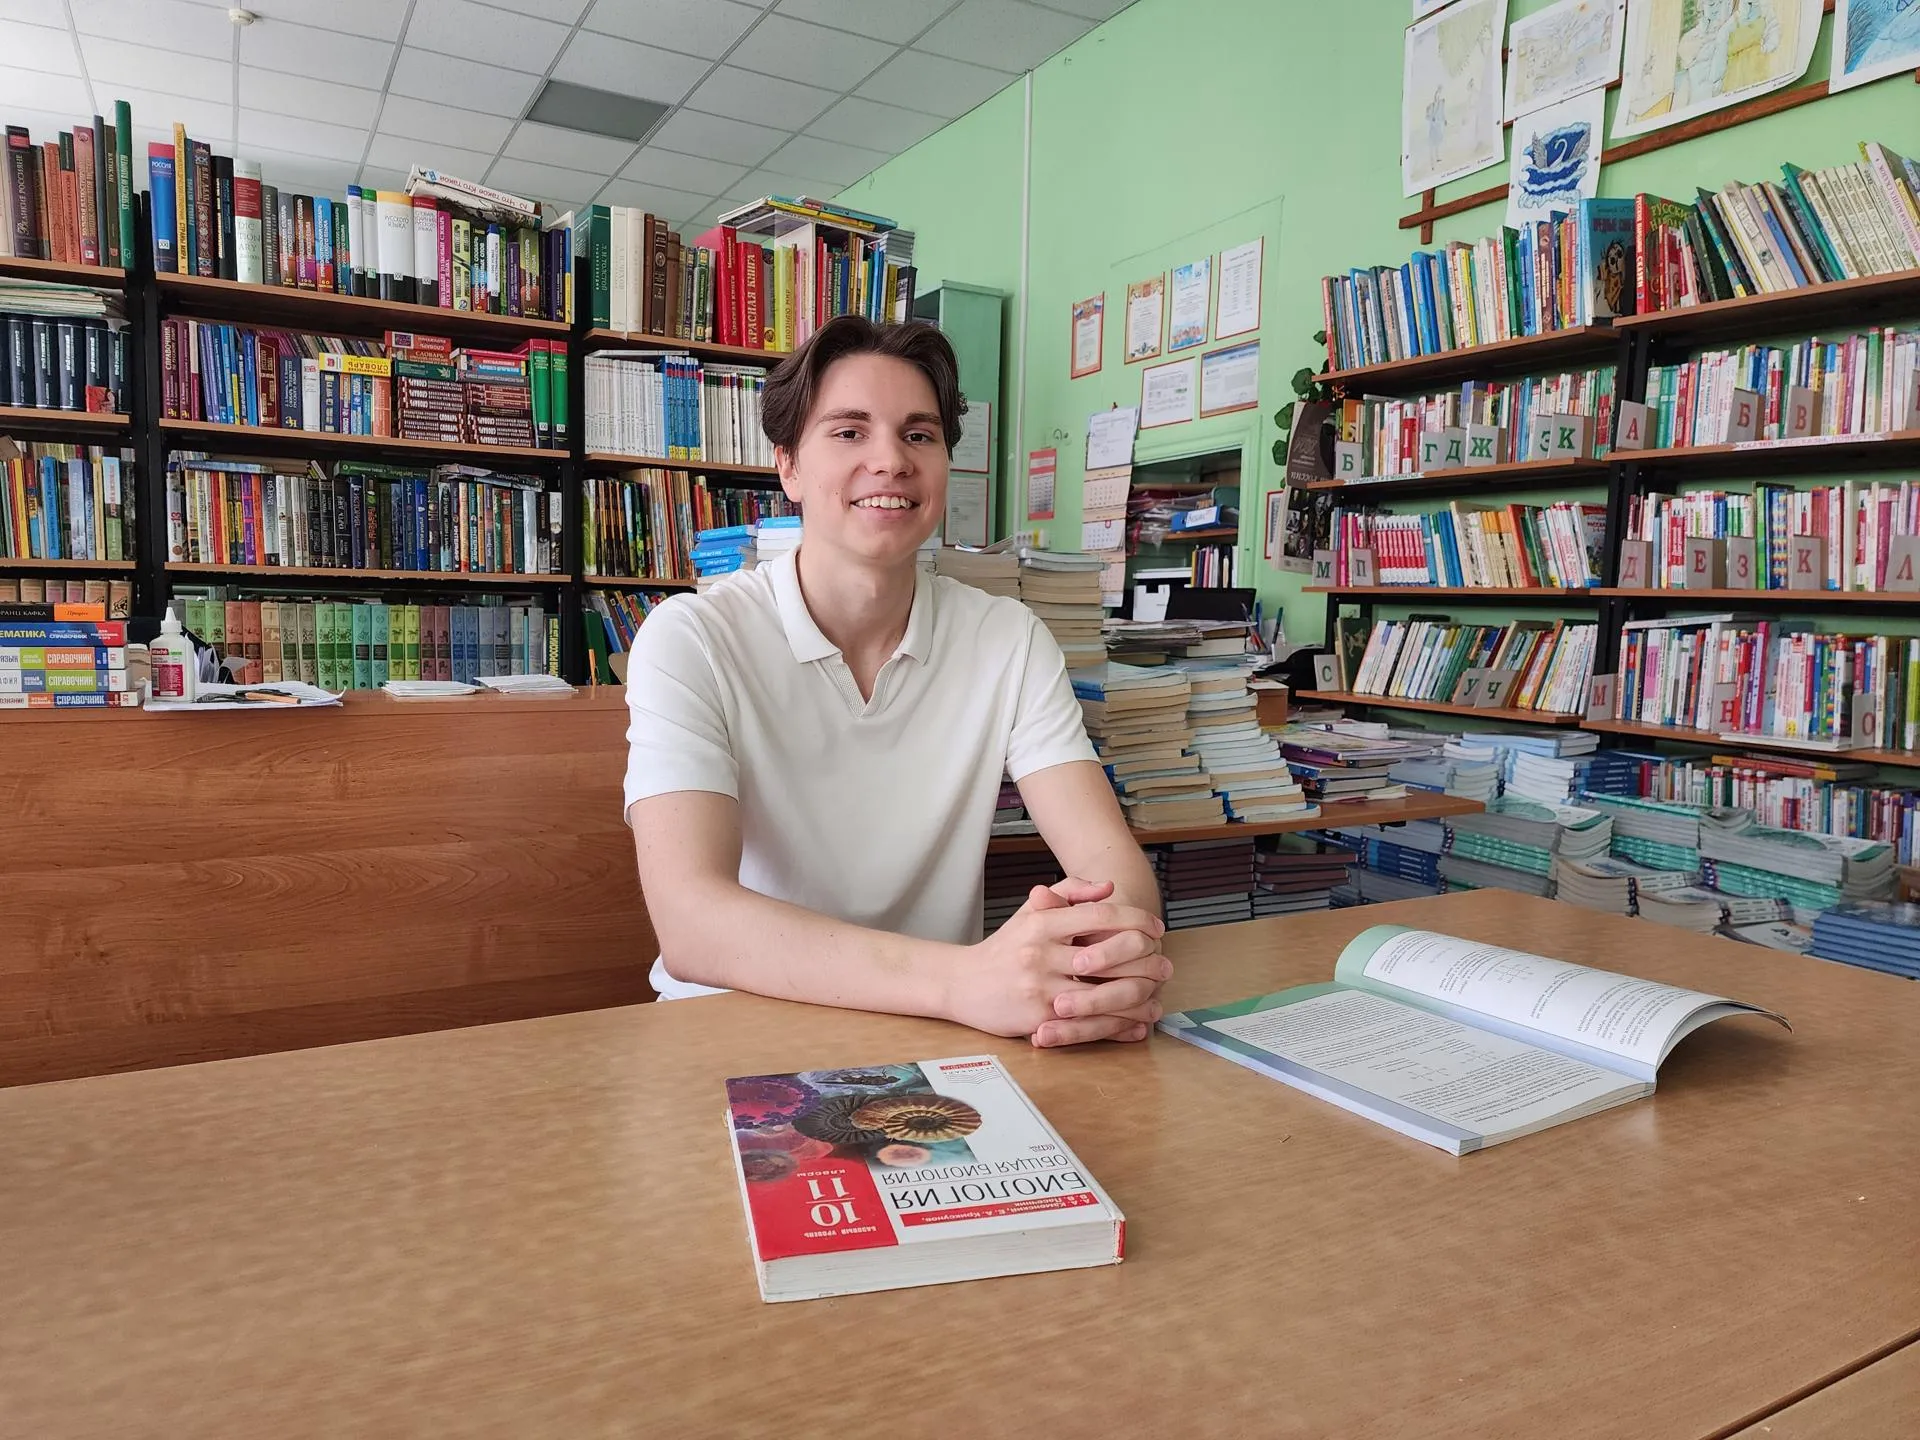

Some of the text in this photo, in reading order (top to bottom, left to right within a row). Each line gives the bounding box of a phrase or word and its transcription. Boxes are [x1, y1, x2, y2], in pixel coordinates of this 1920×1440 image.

[15, 155, 26, 194] РОССИЯНЕ
[152, 160, 172, 170] РОССИЯ
[440, 174, 460, 187] такой
[1880, 165, 1892, 190] СКАЗОК
[384, 215, 409, 224] РУССКОГО
[747, 254, 758, 344] КРАСНАЯ КНИГА
[348, 361, 388, 371] СЛОВАРЬ
[1738, 404, 1752, 427] Б
[1795, 406, 1807, 430] В
[1558, 426, 1576, 450] К
[1626, 417, 1639, 440] А
[1424, 443, 1438, 462] Г
[1446, 440, 1462, 460] Д
[1471, 436, 1494, 458] Ж
[1342, 452, 1354, 472] Б
[171, 512, 181, 522] 13
[1316, 562, 1332, 578] М
[1356, 559, 1367, 578] П
[1622, 556, 1638, 579] Д
[1694, 550, 1707, 573] Е
[1736, 554, 1748, 578] З
[1797, 548, 1813, 573] К
[1896, 558, 1914, 580] Л
[47, 653, 92, 664] СПРАВОЧНИК
[48, 676, 94, 686] СПРАВОЧНИК
[1322, 664, 1332, 682] С
[1463, 678, 1480, 696] У
[1488, 680, 1502, 700] Ч
[1592, 685, 1606, 706] М
[56, 694, 105, 705] СПРАВОЧНИК
[1720, 700, 1734, 723] Н
[1862, 705, 1874, 728] О
[881, 1154, 1068, 1185] ОБЩАЯ БИОЛОГИЯ
[806, 1177, 850, 1201] 11
[889, 1171, 1086, 1210] БИОЛОГИЯ
[810, 1201, 862, 1227] 10
[804, 1226, 877, 1238] БАЗОВЫЙ УРОВЕНЬ
